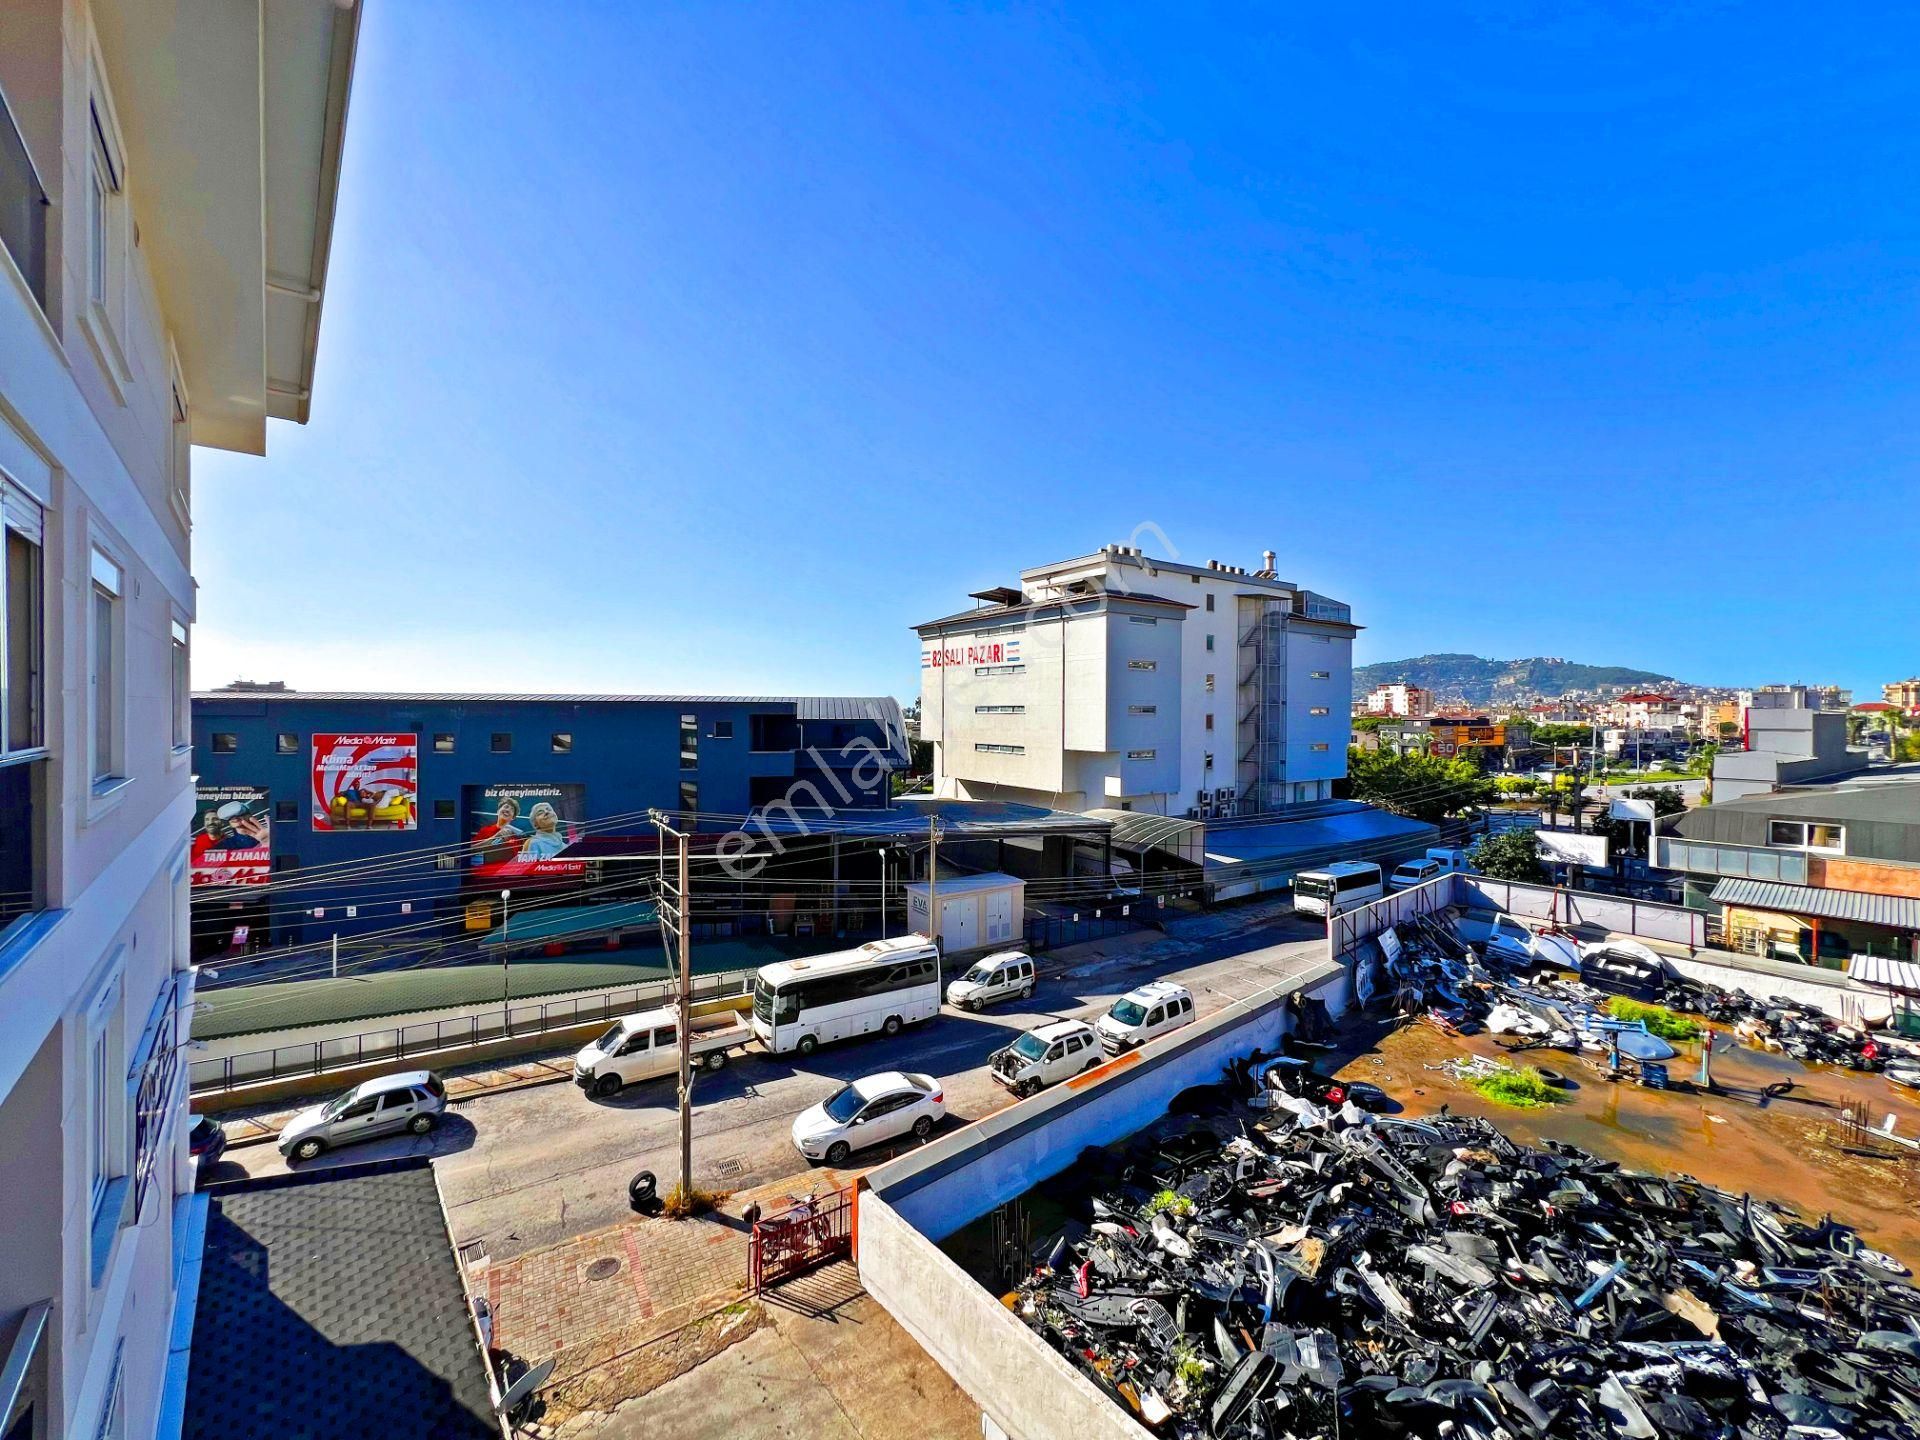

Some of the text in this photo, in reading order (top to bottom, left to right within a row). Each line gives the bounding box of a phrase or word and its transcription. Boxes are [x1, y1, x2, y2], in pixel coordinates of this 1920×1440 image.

[932, 650, 942, 667] 82
[967, 643, 1004, 665] PAZARI
[232, 792, 264, 800] bizden.
[485, 788, 562, 798] biz deneyimletiriz.
[204, 851, 227, 862] TAM
[912, 895, 928, 910] EVA
